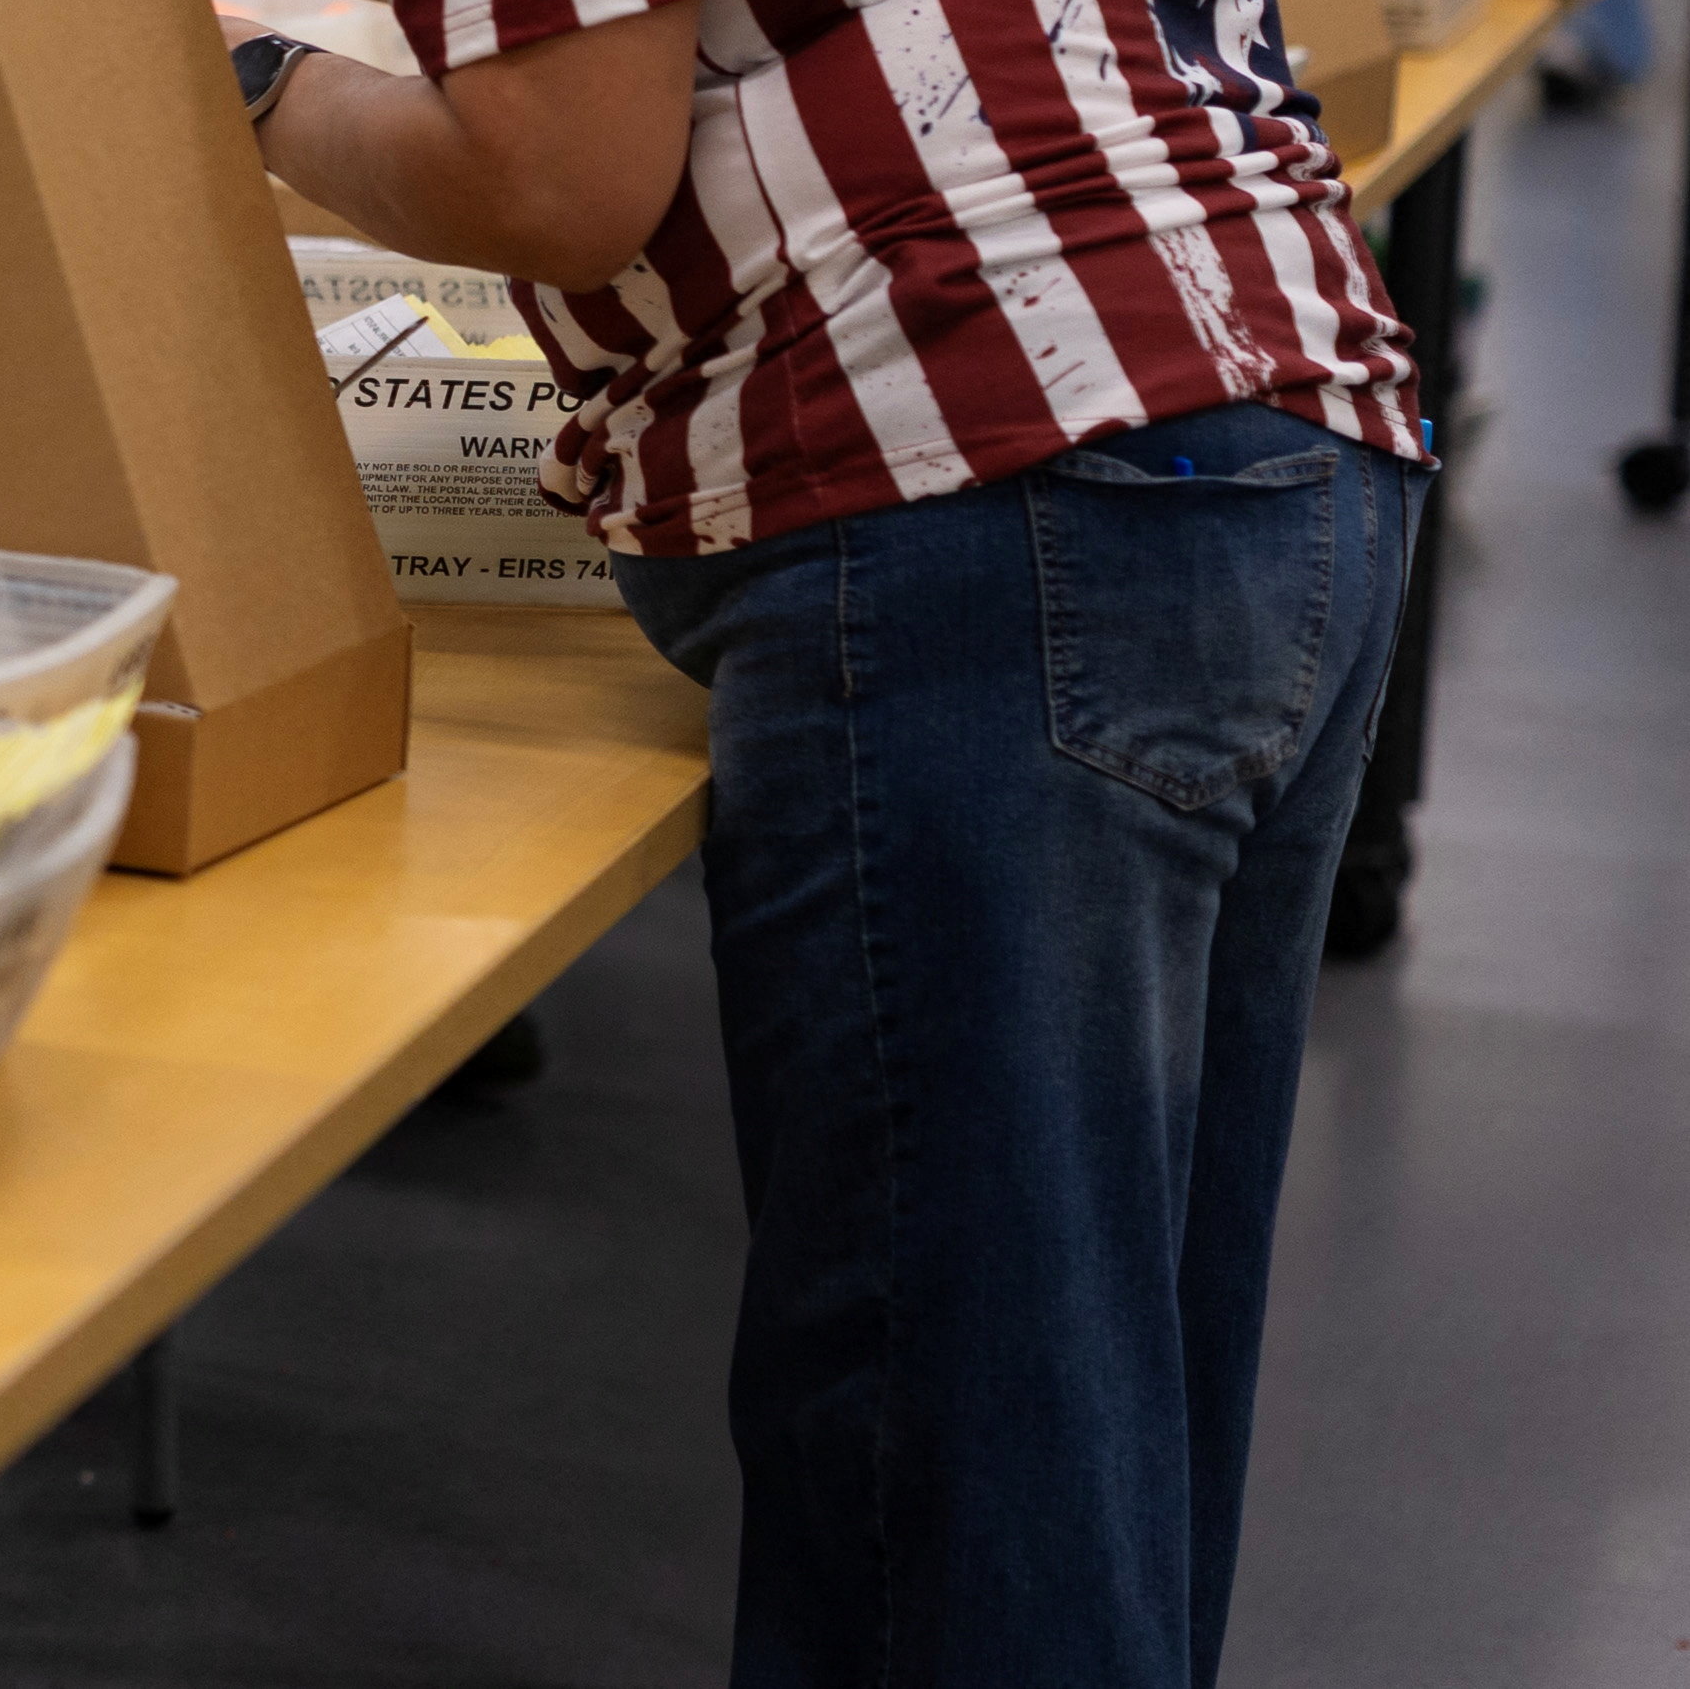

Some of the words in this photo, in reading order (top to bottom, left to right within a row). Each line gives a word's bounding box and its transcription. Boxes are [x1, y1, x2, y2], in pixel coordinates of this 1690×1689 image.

[354, 377, 516, 412] STATES
[372, 463, 393, 471] NOT
[396, 463, 410, 472] BE
[412, 464, 441, 473] SOLD
[443, 464, 459, 473] OR
[461, 465, 516, 475] RECYCLED
[406, 474, 427, 483] FOR
[429, 475, 451, 484] ANY
[453, 475, 502, 485] PURPOSE
[418, 485, 437, 494] THE
[440, 486, 480, 495] POSTAL
[482, 487, 526, 496] SERVICE
[400, 495, 420, 504] THE
[422, 495, 475, 505] LOCATION
[477, 496, 492, 505] OF
[495, 497, 524, 506] THEIR
[382, 505, 396, 514] OF
[398, 505, 413, 514] UP
[415, 506, 430, 515] TO
[432, 507, 465, 516] THREE
[507, 508, 523, 517] OR
[525, 509, 554, 518] BOTH
[391, 555, 472, 577] TRAY
[498, 558, 566, 580] EIRS
